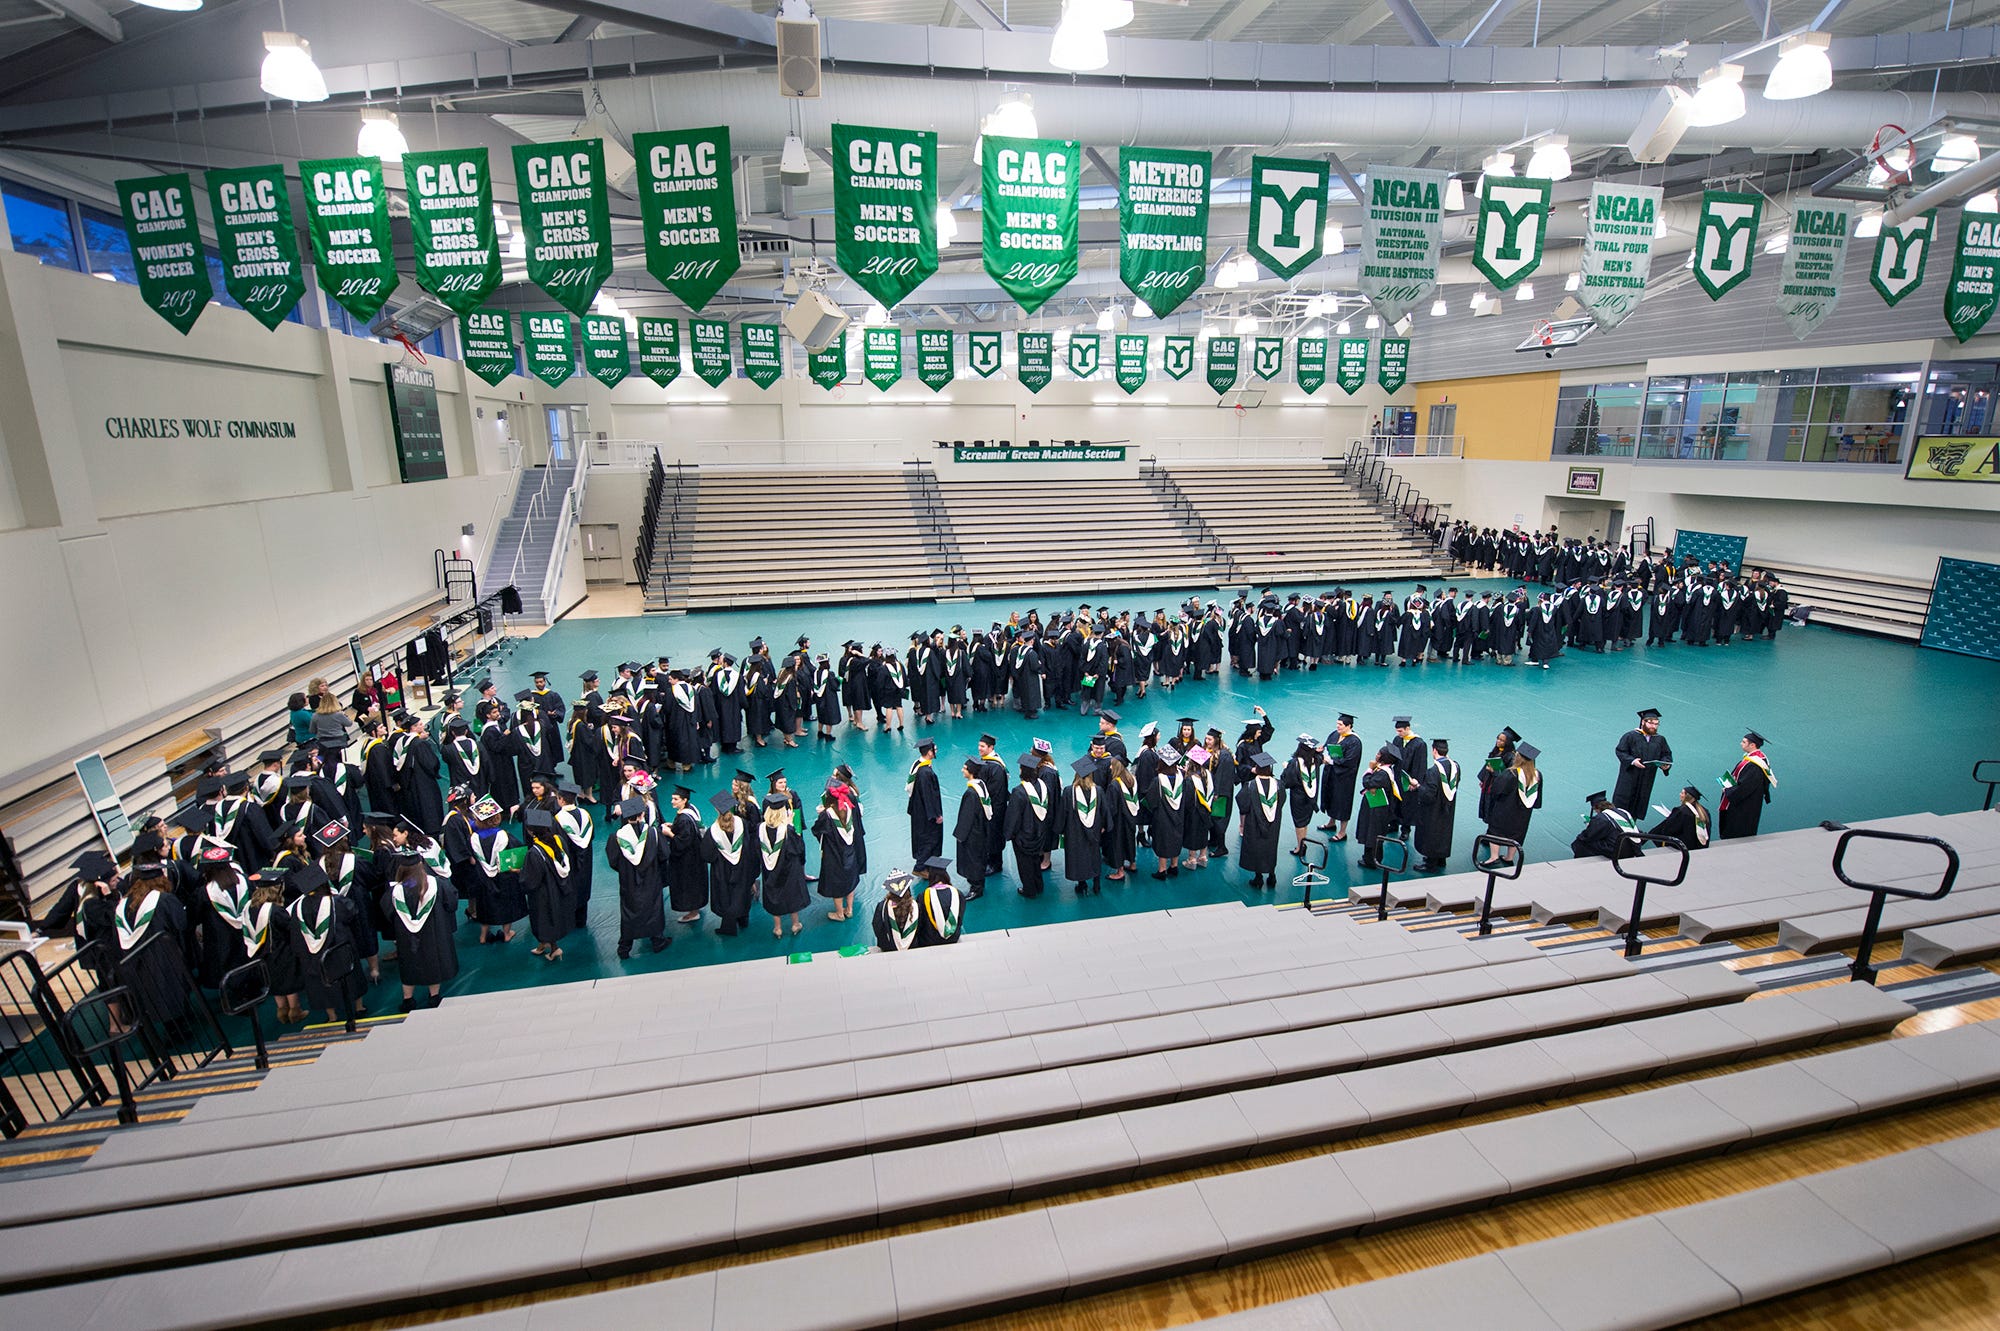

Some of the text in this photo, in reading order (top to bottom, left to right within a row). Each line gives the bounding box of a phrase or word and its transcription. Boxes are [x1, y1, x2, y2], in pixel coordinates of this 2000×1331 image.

[650, 142, 716, 178] CAC
[849, 140, 922, 176] CAC
[528, 153, 591, 189] CAC
[998, 150, 1066, 185] CAC
[1129, 160, 1203, 188] METRO
[314, 169, 372, 203] CAC
[416, 162, 478, 196] CAC
[654, 178, 718, 193] CHAMPIONS
[851, 175, 922, 191] CHAMPIONS
[220, 180, 275, 212] CAC
[531, 188, 592, 203] CHAMPIONS
[998, 183, 1066, 199] CHAMPIONS
[1129, 186, 1202, 204] CONFERENCE
[1372, 179, 1440, 210] NCAA
[131, 188, 183, 220] CAC
[318, 202, 374, 216] CHAMPIONS
[420, 196, 479, 210] CHAMPIONS
[1134, 204, 1196, 217] CHAMPIONS
[1596, 194, 1654, 222] NCAA
[225, 212, 279, 225] CHAMPIONS
[542, 209, 587, 226] MEN'S
[664, 206, 712, 224] MEN'S
[860, 204, 913, 222] MEN'S
[1006, 212, 1057, 229] MEN'S
[1370, 209, 1438, 223] DIVISION III
[136, 219, 186, 233] CHAMPIONS
[431, 217, 475, 234] MEN'S
[1594, 224, 1653, 236] DIVISION III
[1795, 210, 1846, 236] NCAA
[235, 230, 275, 246] MEN'S
[329, 229, 372, 245] MEN'S
[543, 226, 590, 243] CROSS
[659, 228, 720, 246] SOCCER
[854, 225, 920, 244] SOCCER
[1380, 228, 1425, 238] NATIONAL
[432, 234, 478, 250] CROSS
[1000, 233, 1063, 250] SOCCER
[1127, 234, 1202, 251] WRESTLING
[1375, 238, 1429, 250] WRESTLING
[1594, 241, 1648, 254] FINAL FOUR
[1793, 237, 1843, 248] DIVISION III
[137, 243, 194, 260] WOMEN'S
[237, 246, 279, 262] CROSS
[327, 248, 381, 265] SOCCER
[426, 251, 489, 267] COUNTRY
[535, 243, 599, 261] COUNTRY
[1377, 250, 1424, 260] CHAMPION
[1799, 252, 1832, 261] NATIONAL
[147, 262, 194, 279] SOCCER
[232, 262, 290, 278] COUNTRY
[667, 259, 720, 281] 2011
[858, 256, 918, 275] 2010
[1364, 265, 1434, 280] DUANE BASTRESS
[1603, 260, 1632, 272] MEN'S
[1795, 262, 1833, 271] WRESTLING
[1963, 266, 1993, 279] MEN'S
[546, 266, 594, 287] 2011
[1001, 262, 1060, 287] 2009
[1137, 265, 1202, 288] 2006
[1585, 275, 1645, 288] BASKETBALL
[1795, 272, 1830, 280] CHAMPION
[337, 278, 381, 296] 2012
[437, 273, 483, 292] 2012
[1957, 281, 1994, 294] SOCCER
[245, 284, 287, 312] 2013
[1374, 282, 1431, 301] 2006
[159, 289, 196, 317] 2013
[1591, 293, 1634, 314] 2005
[1788, 302, 1825, 321] 2005
[468, 314, 504, 330] CAC
[530, 318, 564, 333] CAC
[587, 321, 620, 335] CAC
[643, 322, 673, 336] CAC
[696, 324, 724, 338] CAC
[748, 328, 774, 341] CAC
[469, 340, 508, 349] WOMEN'S
[869, 333, 896, 345] CAC
[922, 334, 948, 346] CAC
[1023, 337, 1047, 349] CAC
[1120, 339, 1144, 351] CAC
[1213, 341, 1235, 352] CAC
[467, 350, 512, 359] BASKETBALL
[537, 344, 562, 352] MEN'S
[595, 350, 619, 359] GOLF
[1302, 342, 1323, 353] CAC
[1344, 343, 1365, 354] CAC
[1385, 343, 1405, 354] CAC
[536, 353, 567, 361] SOCCER
[642, 355, 680, 363] BASKETBALL
[818, 355, 838, 363] GOLF
[478, 363, 506, 374] 2014
[540, 367, 566, 379] 2013
[598, 368, 622, 380] 2013
[652, 368, 675, 376] 2012
[702, 368, 724, 376] 2011
[753, 371, 773, 379] 2011
[818, 371, 839, 380] 2009
[395, 366, 433, 387] SPARTANS
[106, 417, 296, 438] CHARLES WOLF GYMNASIUM
[960, 449, 1120, 460] Screamin' Green Machine Section
